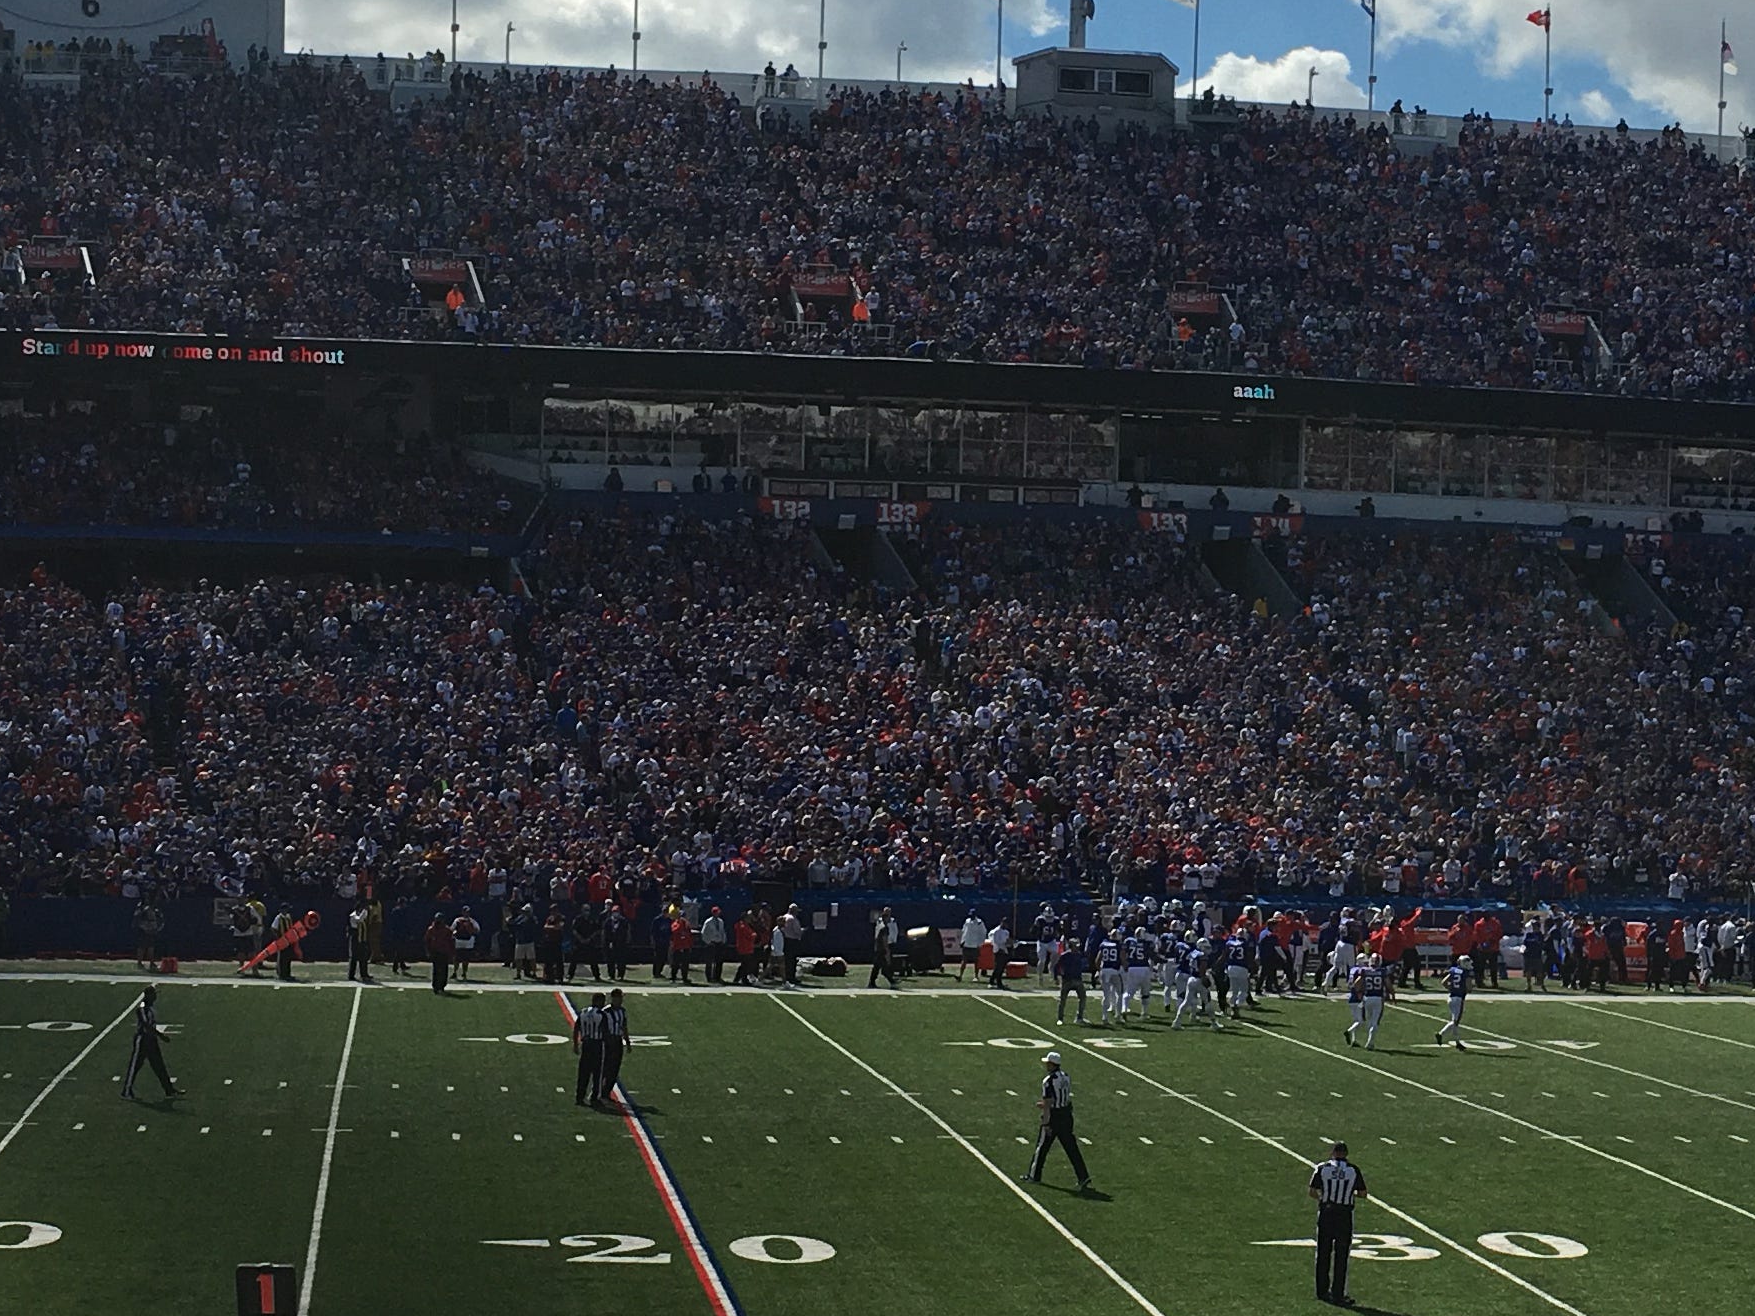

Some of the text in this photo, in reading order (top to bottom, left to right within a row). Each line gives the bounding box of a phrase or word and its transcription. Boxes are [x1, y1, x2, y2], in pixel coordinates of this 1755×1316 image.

[22, 337, 346, 365] Stand up now on and shout
[1233, 383, 1276, 400] aaah
[772, 500, 811, 520] 132
[1128, 946, 1145, 962] 75
[1228, 946, 1245, 961] 73
[257, 1272, 276, 1316] 1
